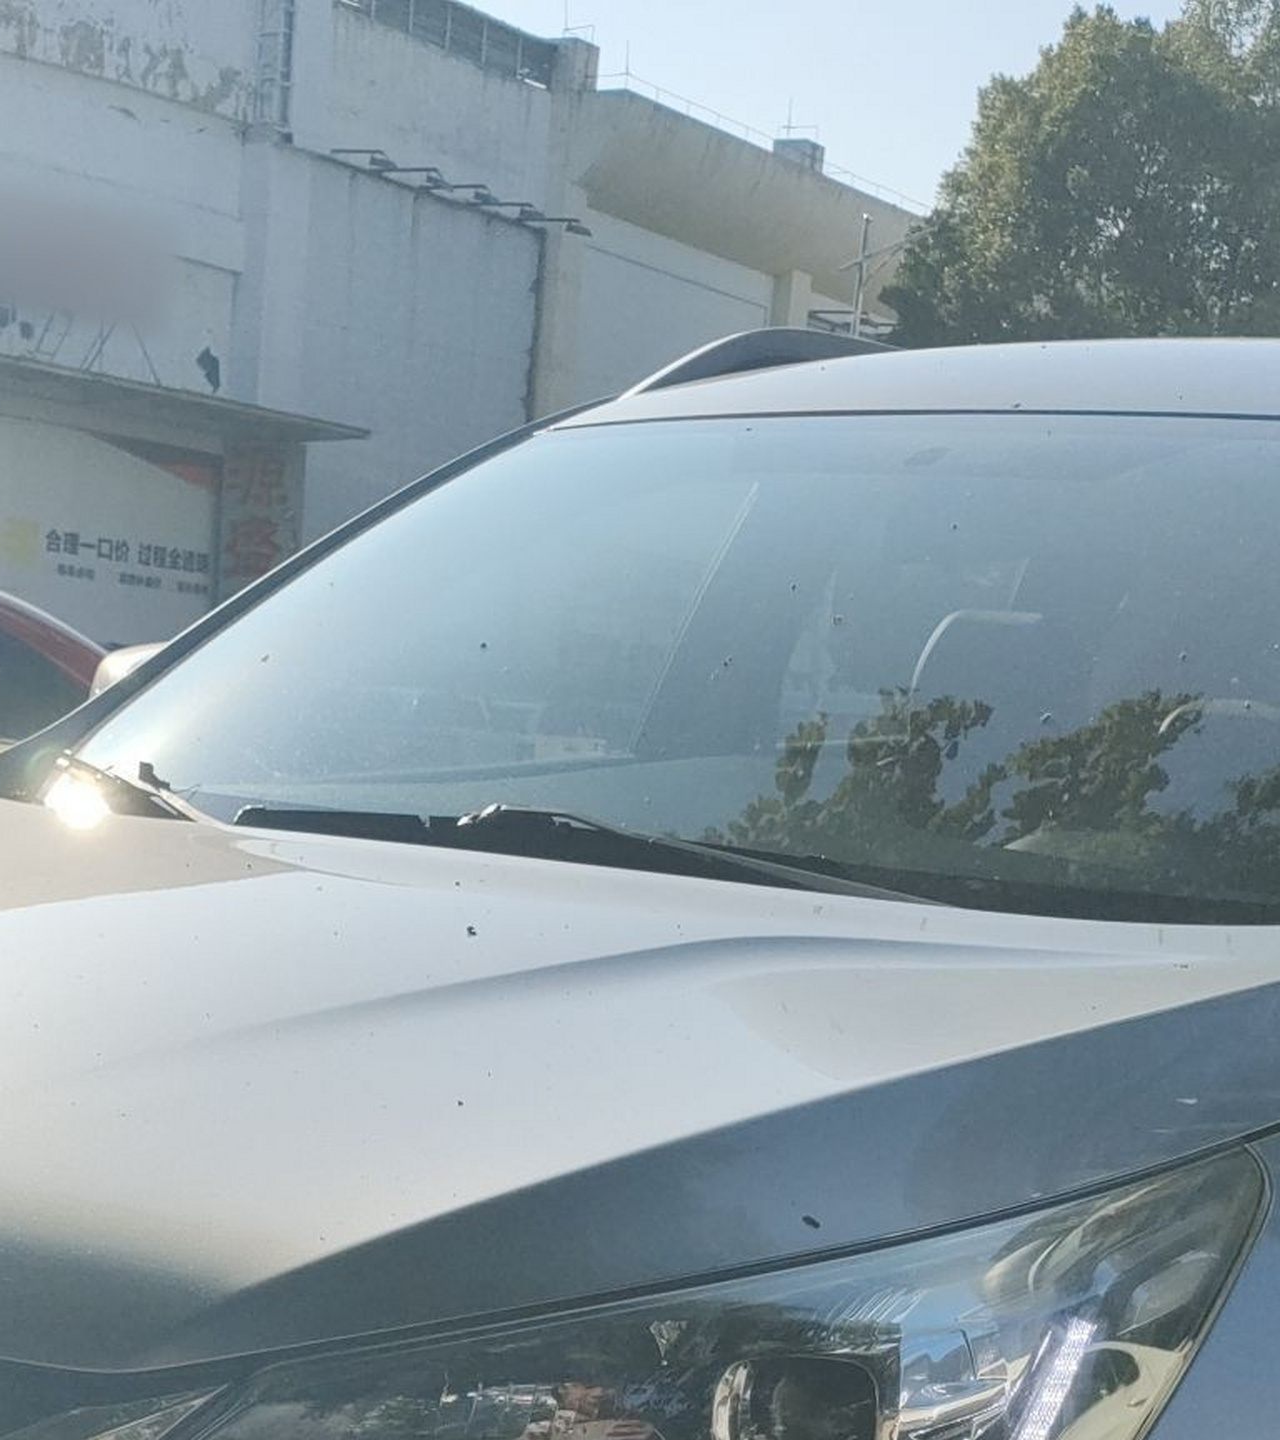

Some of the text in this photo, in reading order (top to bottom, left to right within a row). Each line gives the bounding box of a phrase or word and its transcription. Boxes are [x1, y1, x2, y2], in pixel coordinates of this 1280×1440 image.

[45, 527, 130, 562] 合理一口价
